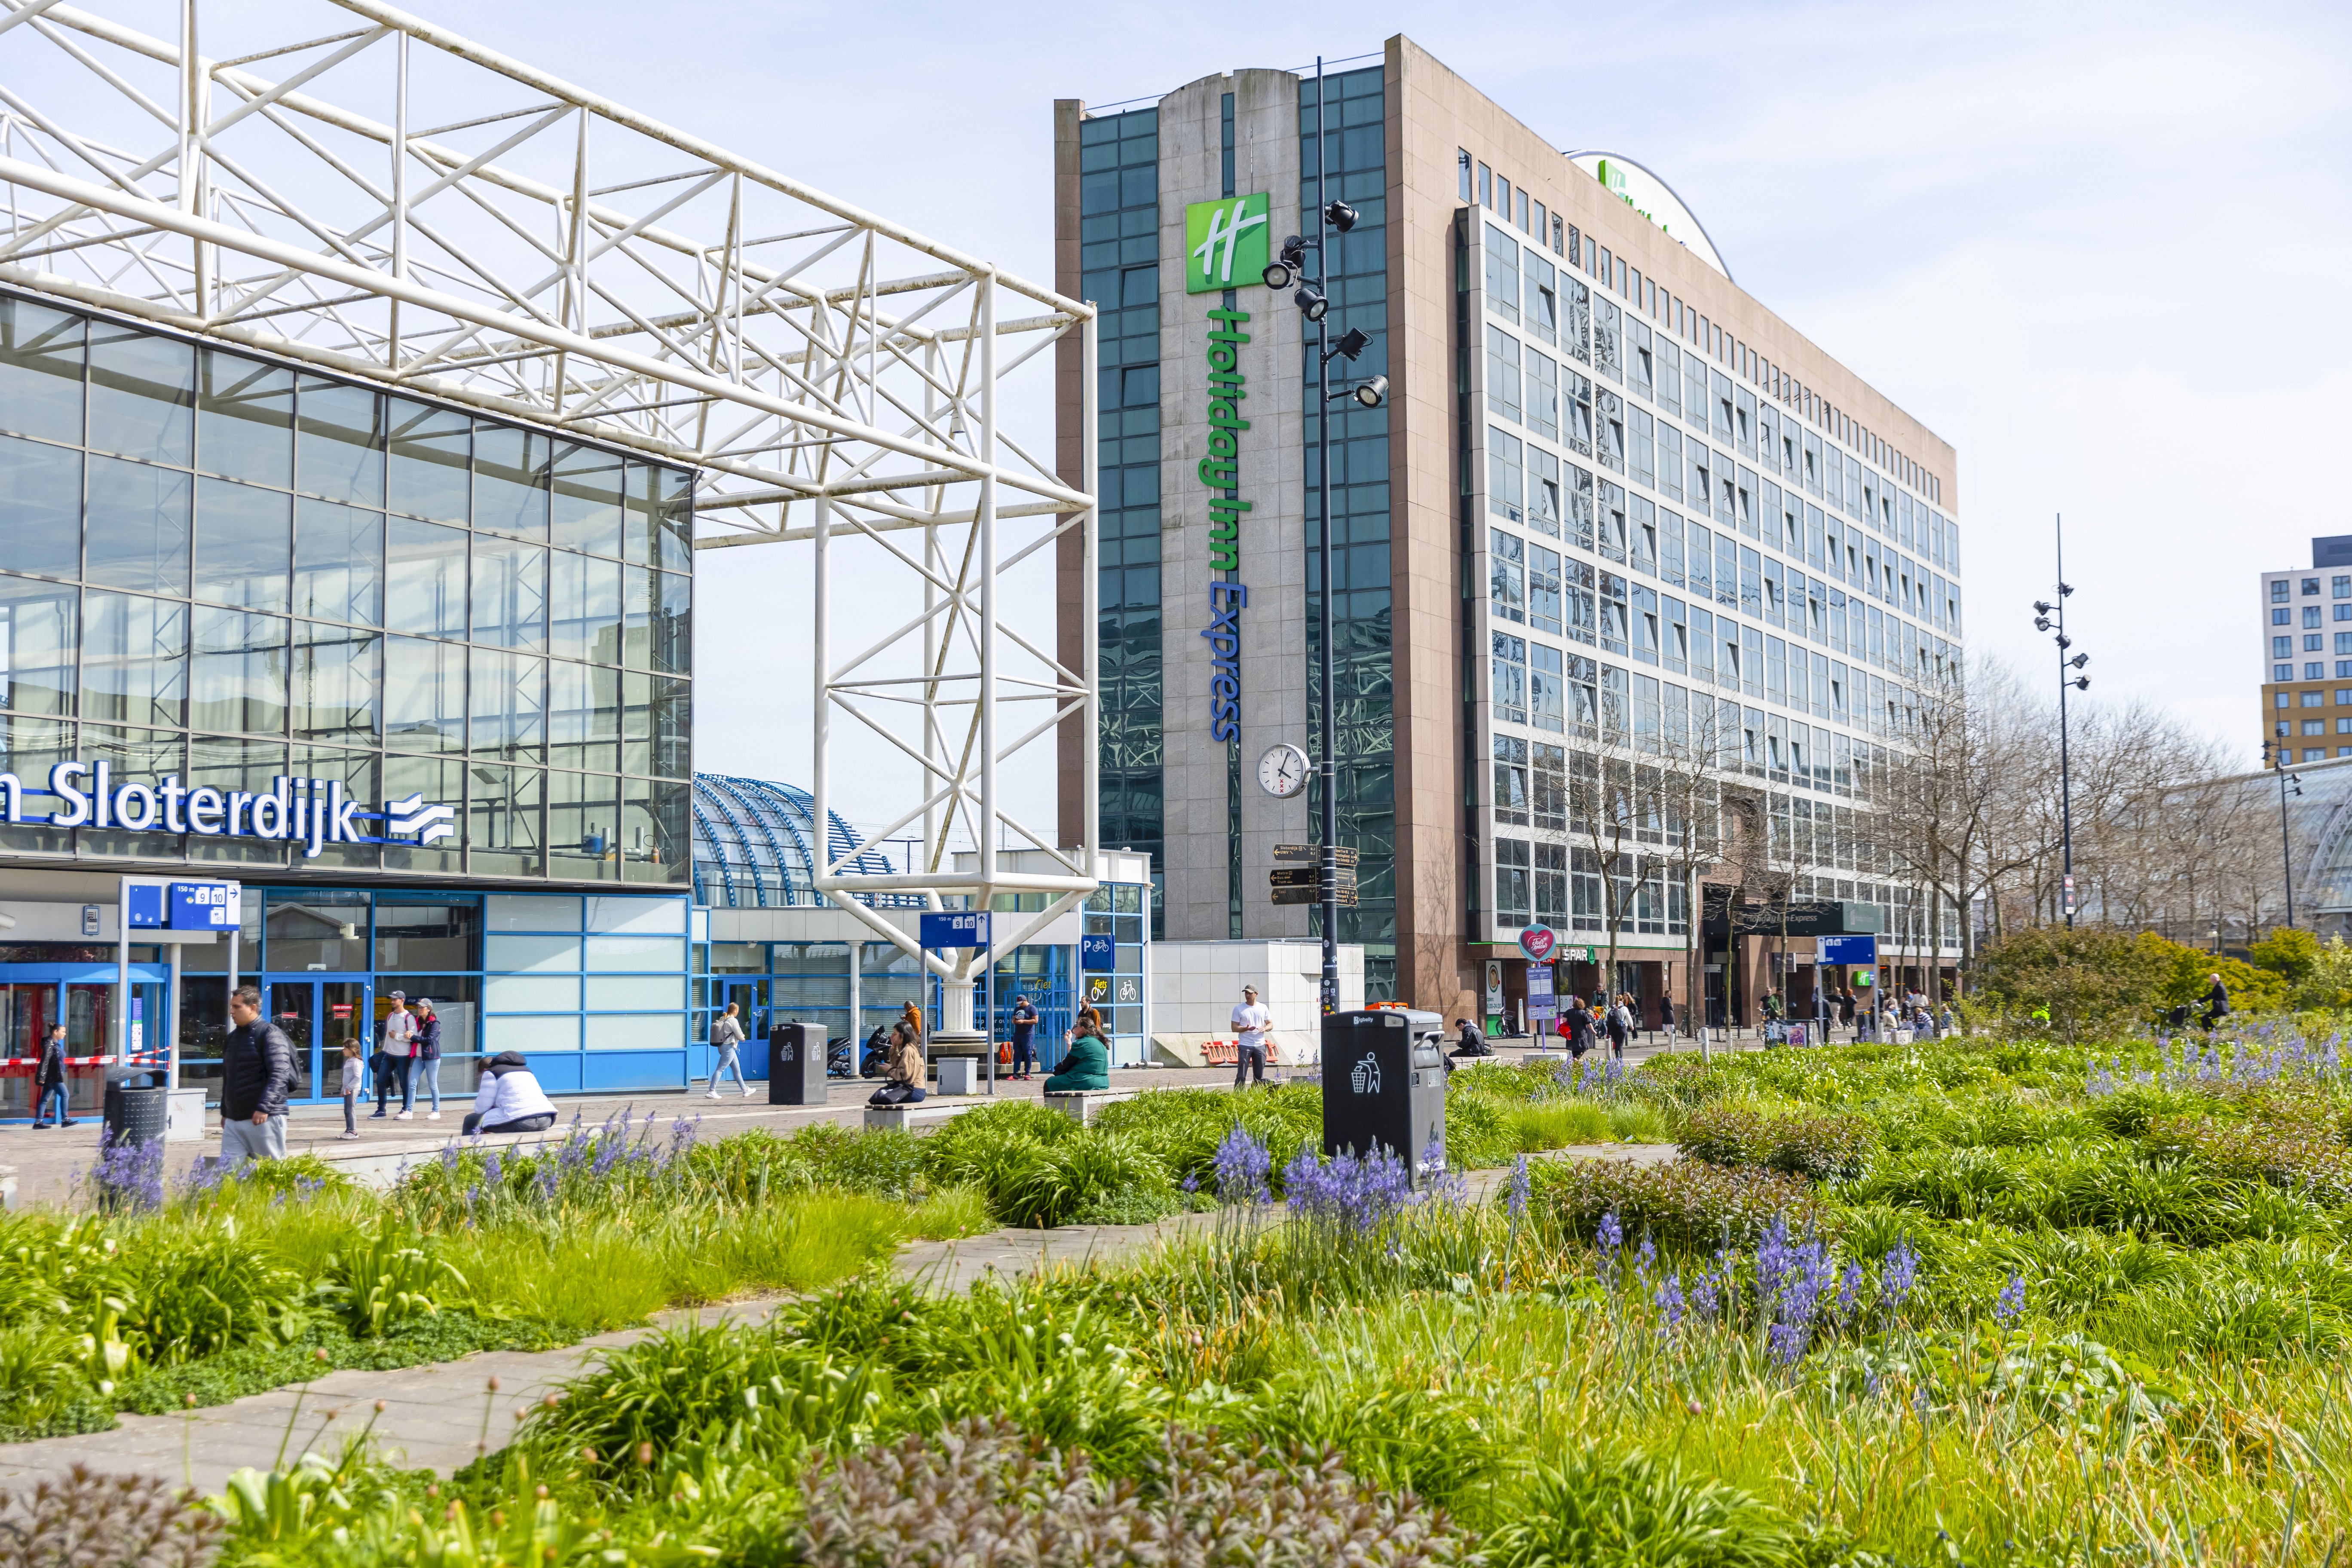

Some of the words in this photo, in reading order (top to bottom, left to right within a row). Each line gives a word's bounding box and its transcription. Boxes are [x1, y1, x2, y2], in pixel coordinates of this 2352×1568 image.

[1198, 305, 1250, 489] Holiday
[1209, 498, 1252, 570] Inn
[1200, 581, 1247, 743] Express
[49, 760, 361, 858] Sloterdijk
[200, 893, 205, 902] 9
[214, 894, 223, 903] 10
[1790, 914, 1818, 923] Express
[1084, 940, 1091, 952] P
[1562, 949, 1588, 961] SPAR
[1094, 979, 1108, 994] fiets
[1354, 1016, 1373, 1024] Bigbelly
